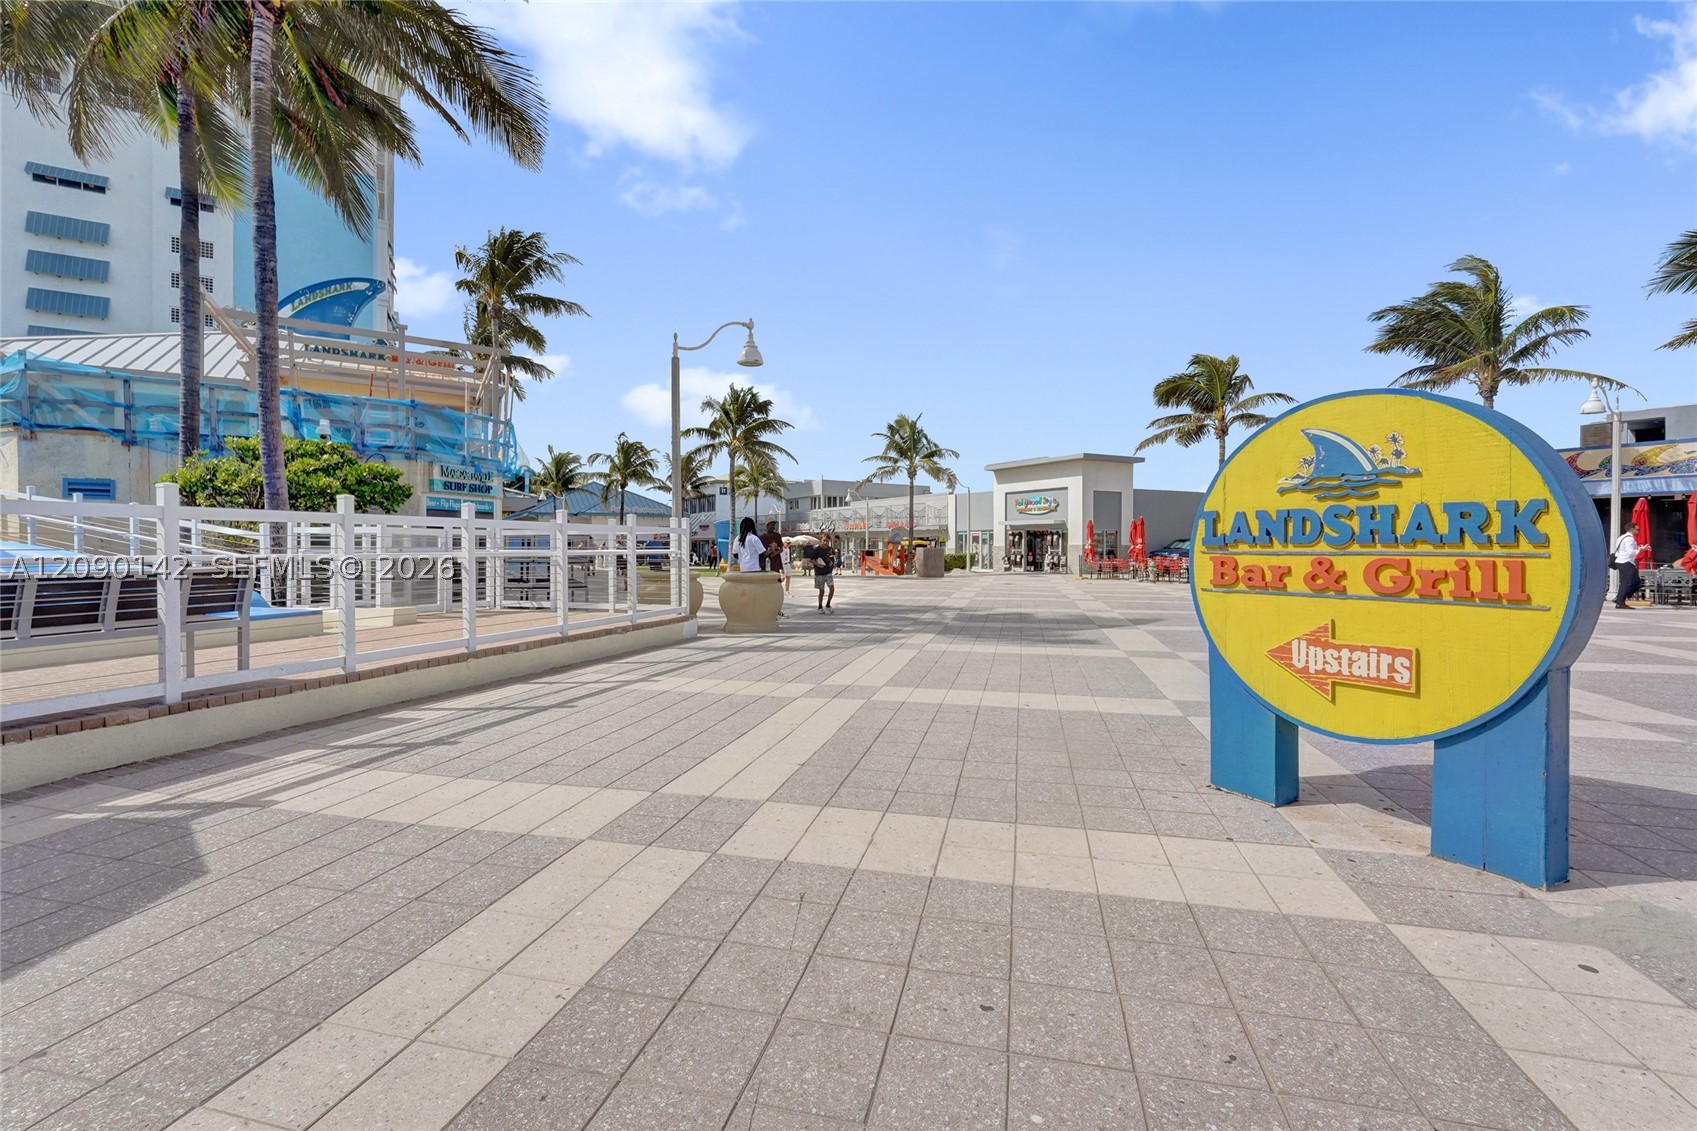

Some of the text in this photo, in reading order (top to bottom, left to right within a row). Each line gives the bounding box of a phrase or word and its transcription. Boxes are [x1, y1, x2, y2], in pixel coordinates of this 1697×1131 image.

[291, 282, 353, 312] LANDSHARK
[304, 345, 386, 361] LANDSHARK
[444, 481, 493, 494] SURF SHOP
[1201, 498, 1549, 549] LANDSHARK
[1209, 555, 1531, 602] Bar & Grill
[1291, 638, 1411, 685] Upstairs
